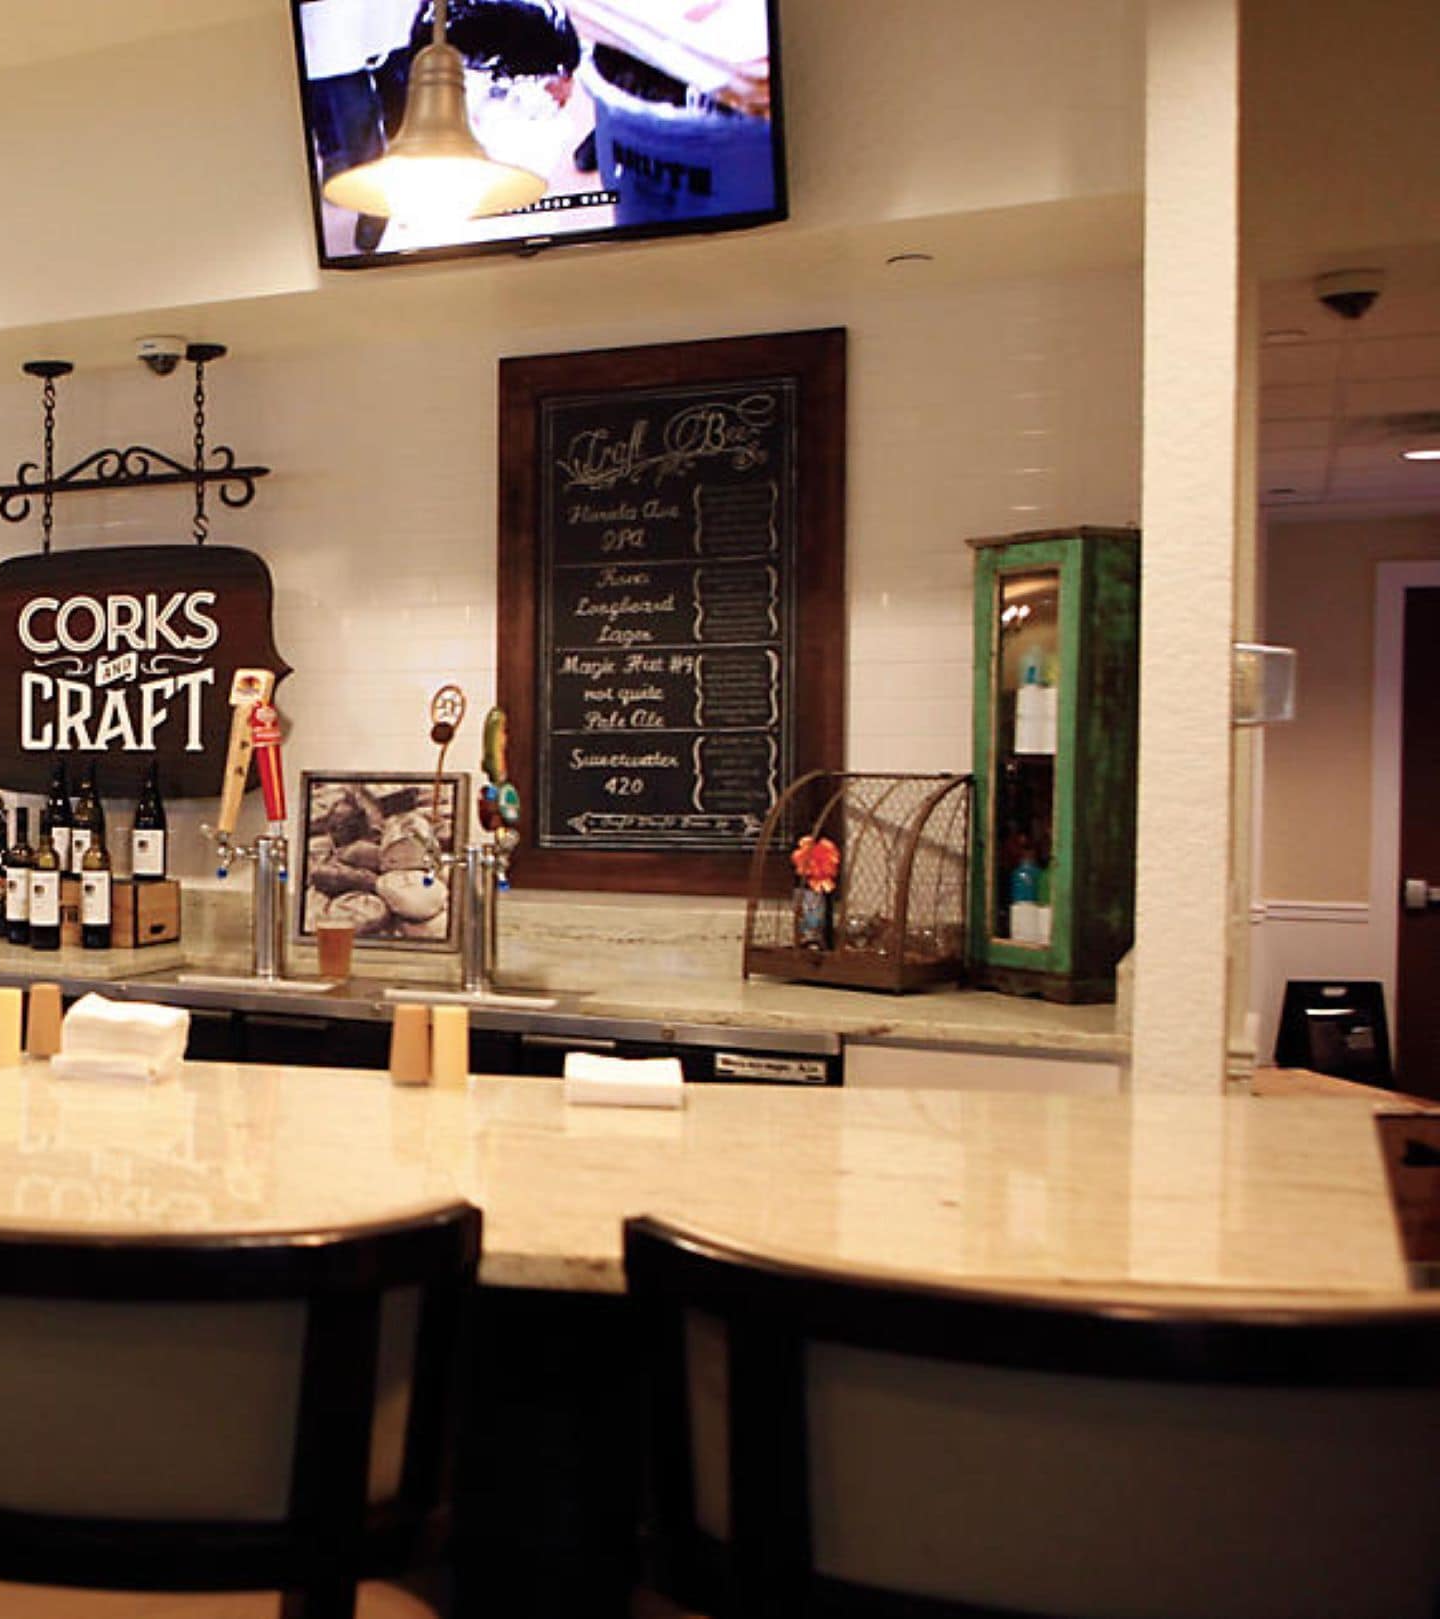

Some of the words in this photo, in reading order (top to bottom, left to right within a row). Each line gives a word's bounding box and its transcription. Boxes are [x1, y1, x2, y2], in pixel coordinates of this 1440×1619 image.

[574, 595, 675, 621] Longboard
[18, 590, 220, 653] CORKS
[597, 625, 653, 648] Lager
[101, 657, 133, 681] AND
[559, 655, 617, 680] Magic
[584, 687, 614, 701] not
[617, 684, 665, 705] quite
[20, 667, 216, 752] CRAFT
[584, 710, 626, 730] Pale
[630, 708, 666, 728] Ale
[604, 776, 645, 796] 420
